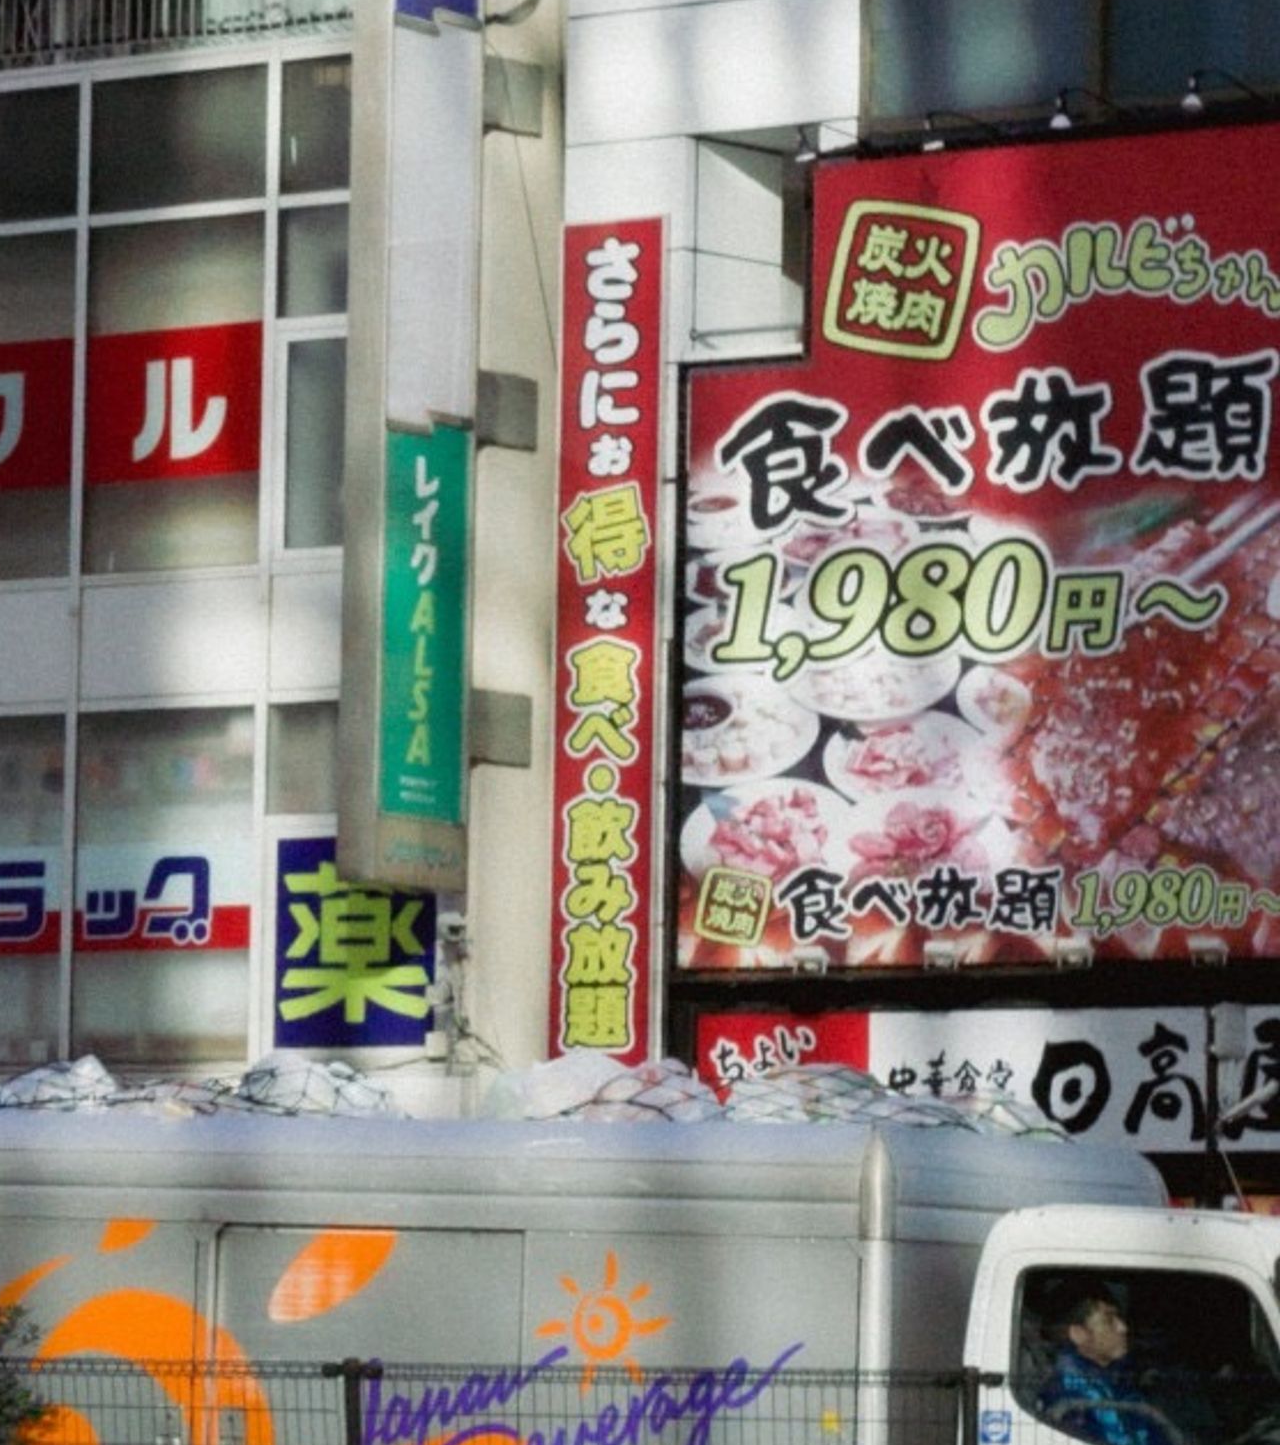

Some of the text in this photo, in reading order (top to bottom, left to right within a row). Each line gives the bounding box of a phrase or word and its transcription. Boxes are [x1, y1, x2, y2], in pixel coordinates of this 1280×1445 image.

[858, 223, 952, 287] 炭火
[716, 351, 1279, 532] 食べ放題
[405, 455, 440, 767] レイクALSA
[562, 237, 648, 1050] さらにお得な食べ・飲み放題
[278, 861, 431, 1023] 薬
[777, 866, 1063, 941] 食べ放題
[714, 1024, 815, 1085] ちょい
